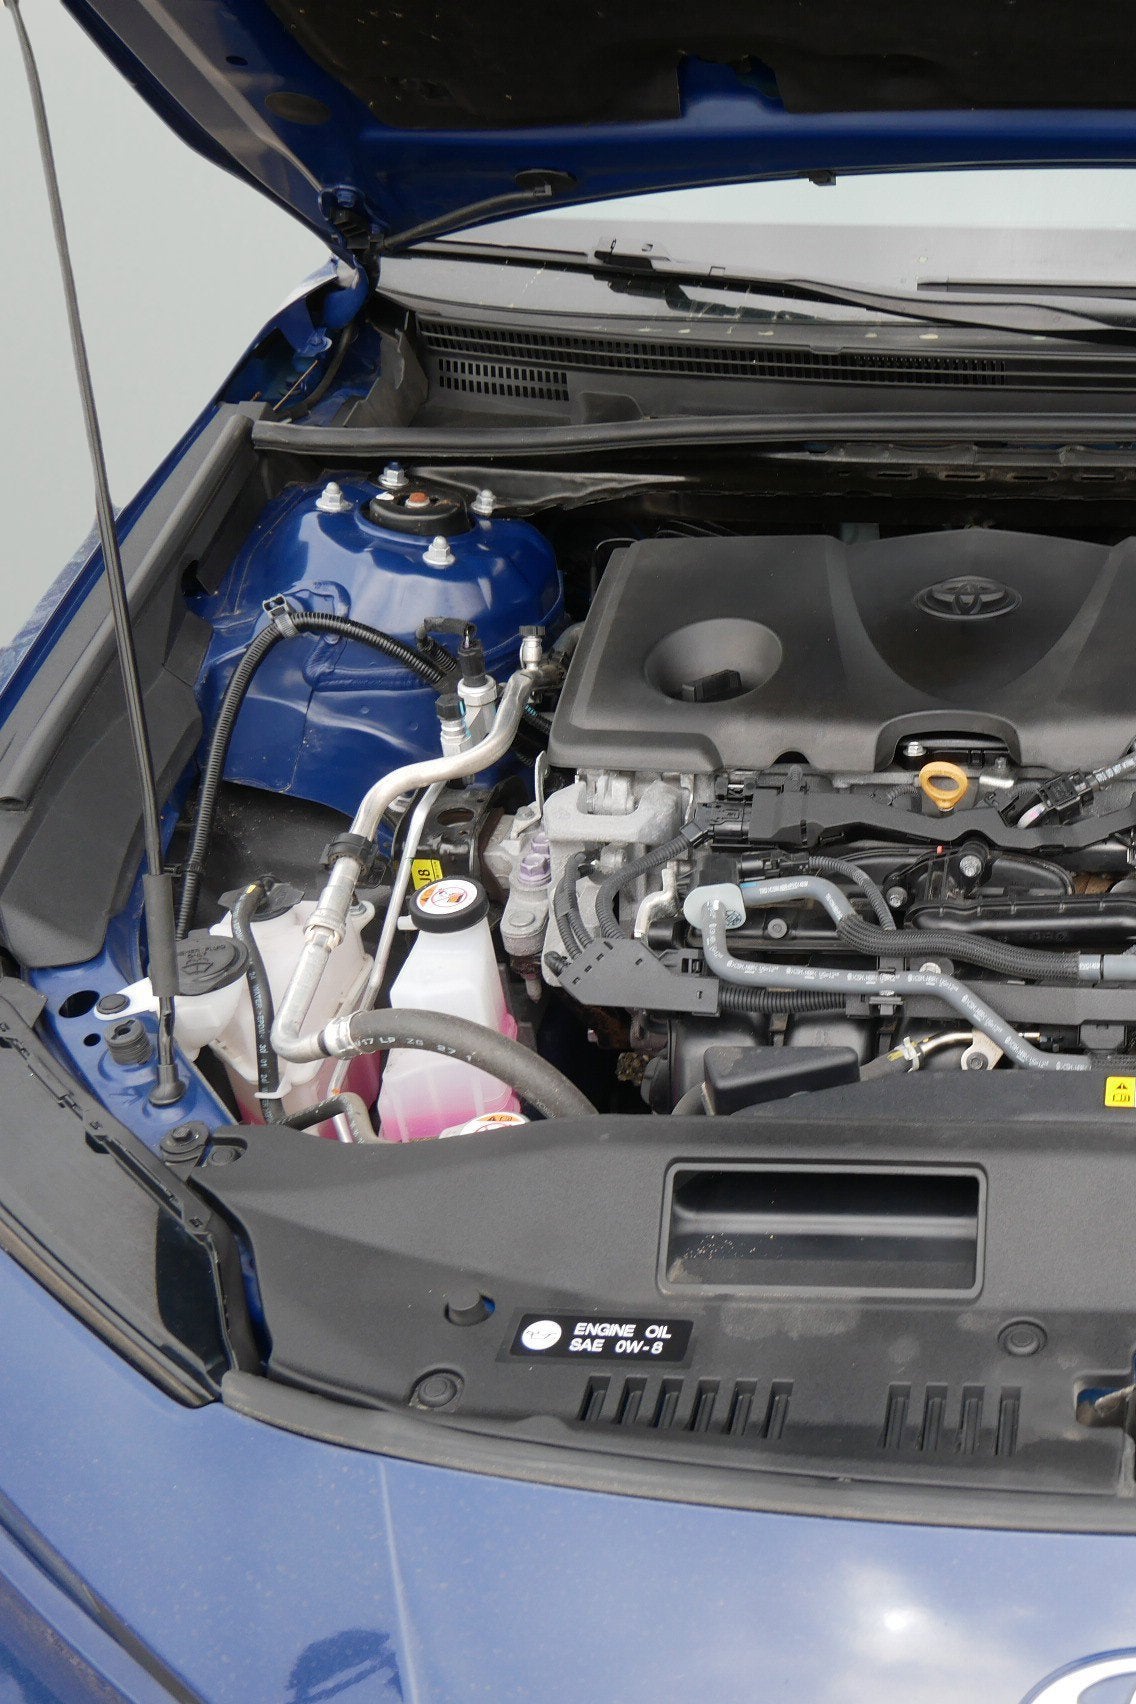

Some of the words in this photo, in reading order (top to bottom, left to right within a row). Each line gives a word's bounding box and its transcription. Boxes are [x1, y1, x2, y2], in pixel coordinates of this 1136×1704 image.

[573, 1322, 636, 1337] ENGINE
[645, 1325, 672, 1339] OIL
[569, 1338, 605, 1352] SAE
